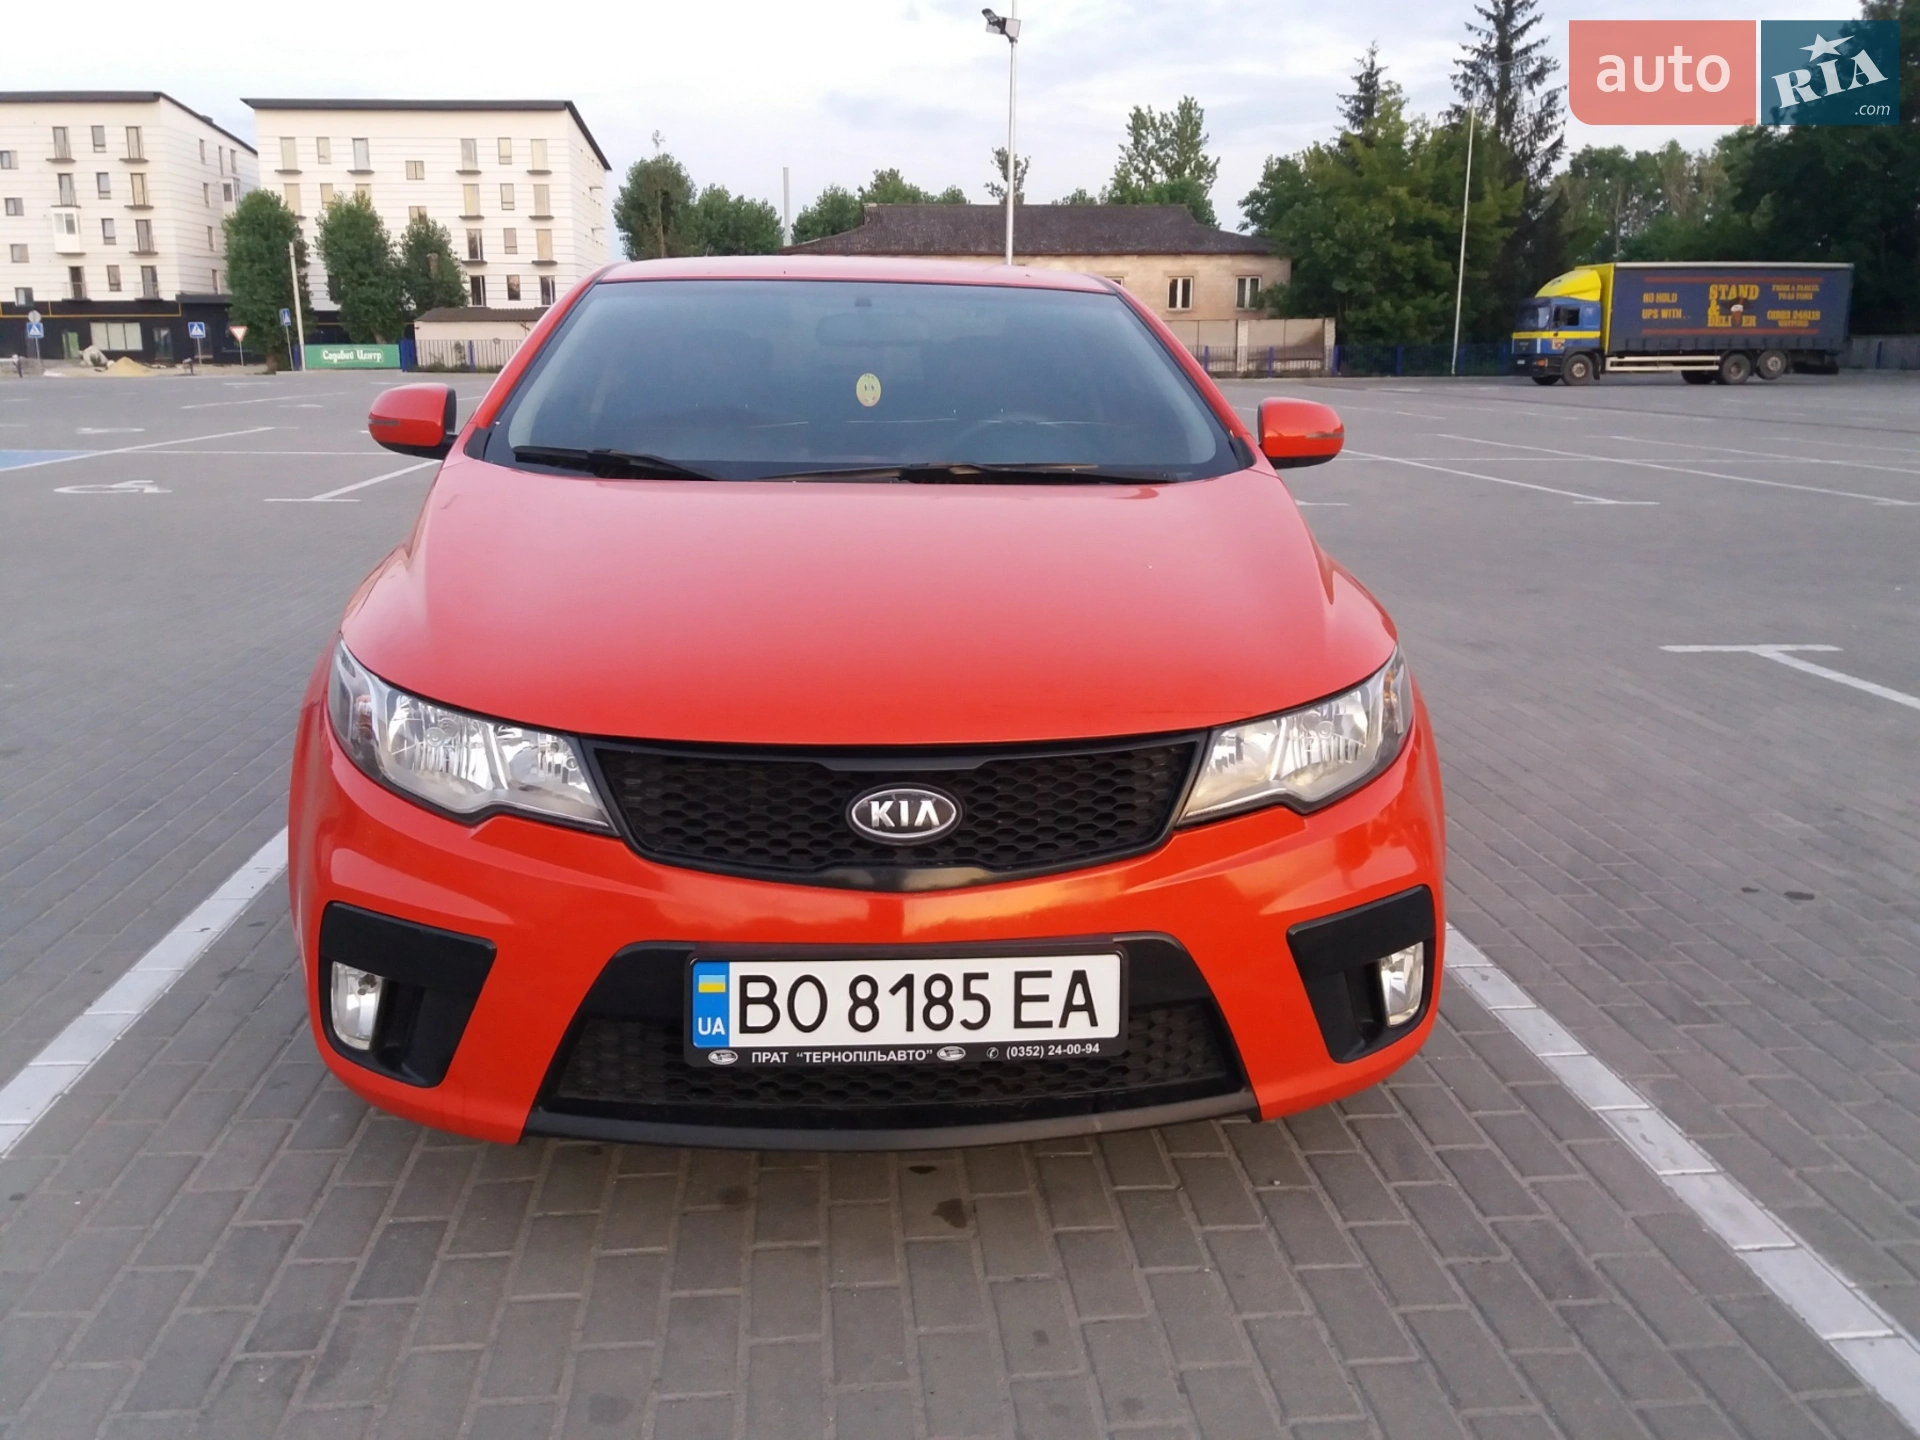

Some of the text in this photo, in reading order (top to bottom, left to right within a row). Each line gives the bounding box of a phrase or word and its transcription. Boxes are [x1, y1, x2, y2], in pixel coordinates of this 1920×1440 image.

[1709, 284, 1760, 300] STAND
[1642, 309, 1658, 318] UPS
[869, 800, 940, 828] KIA
[848, 972, 991, 1033] 8185
[698, 1018, 726, 1036] UA
[751, 1052, 789, 1063] ПРАТ
[1006, 1045, 1045, 1060] (0352)
[1047, 1043, 1100, 1056] 24-00-94
